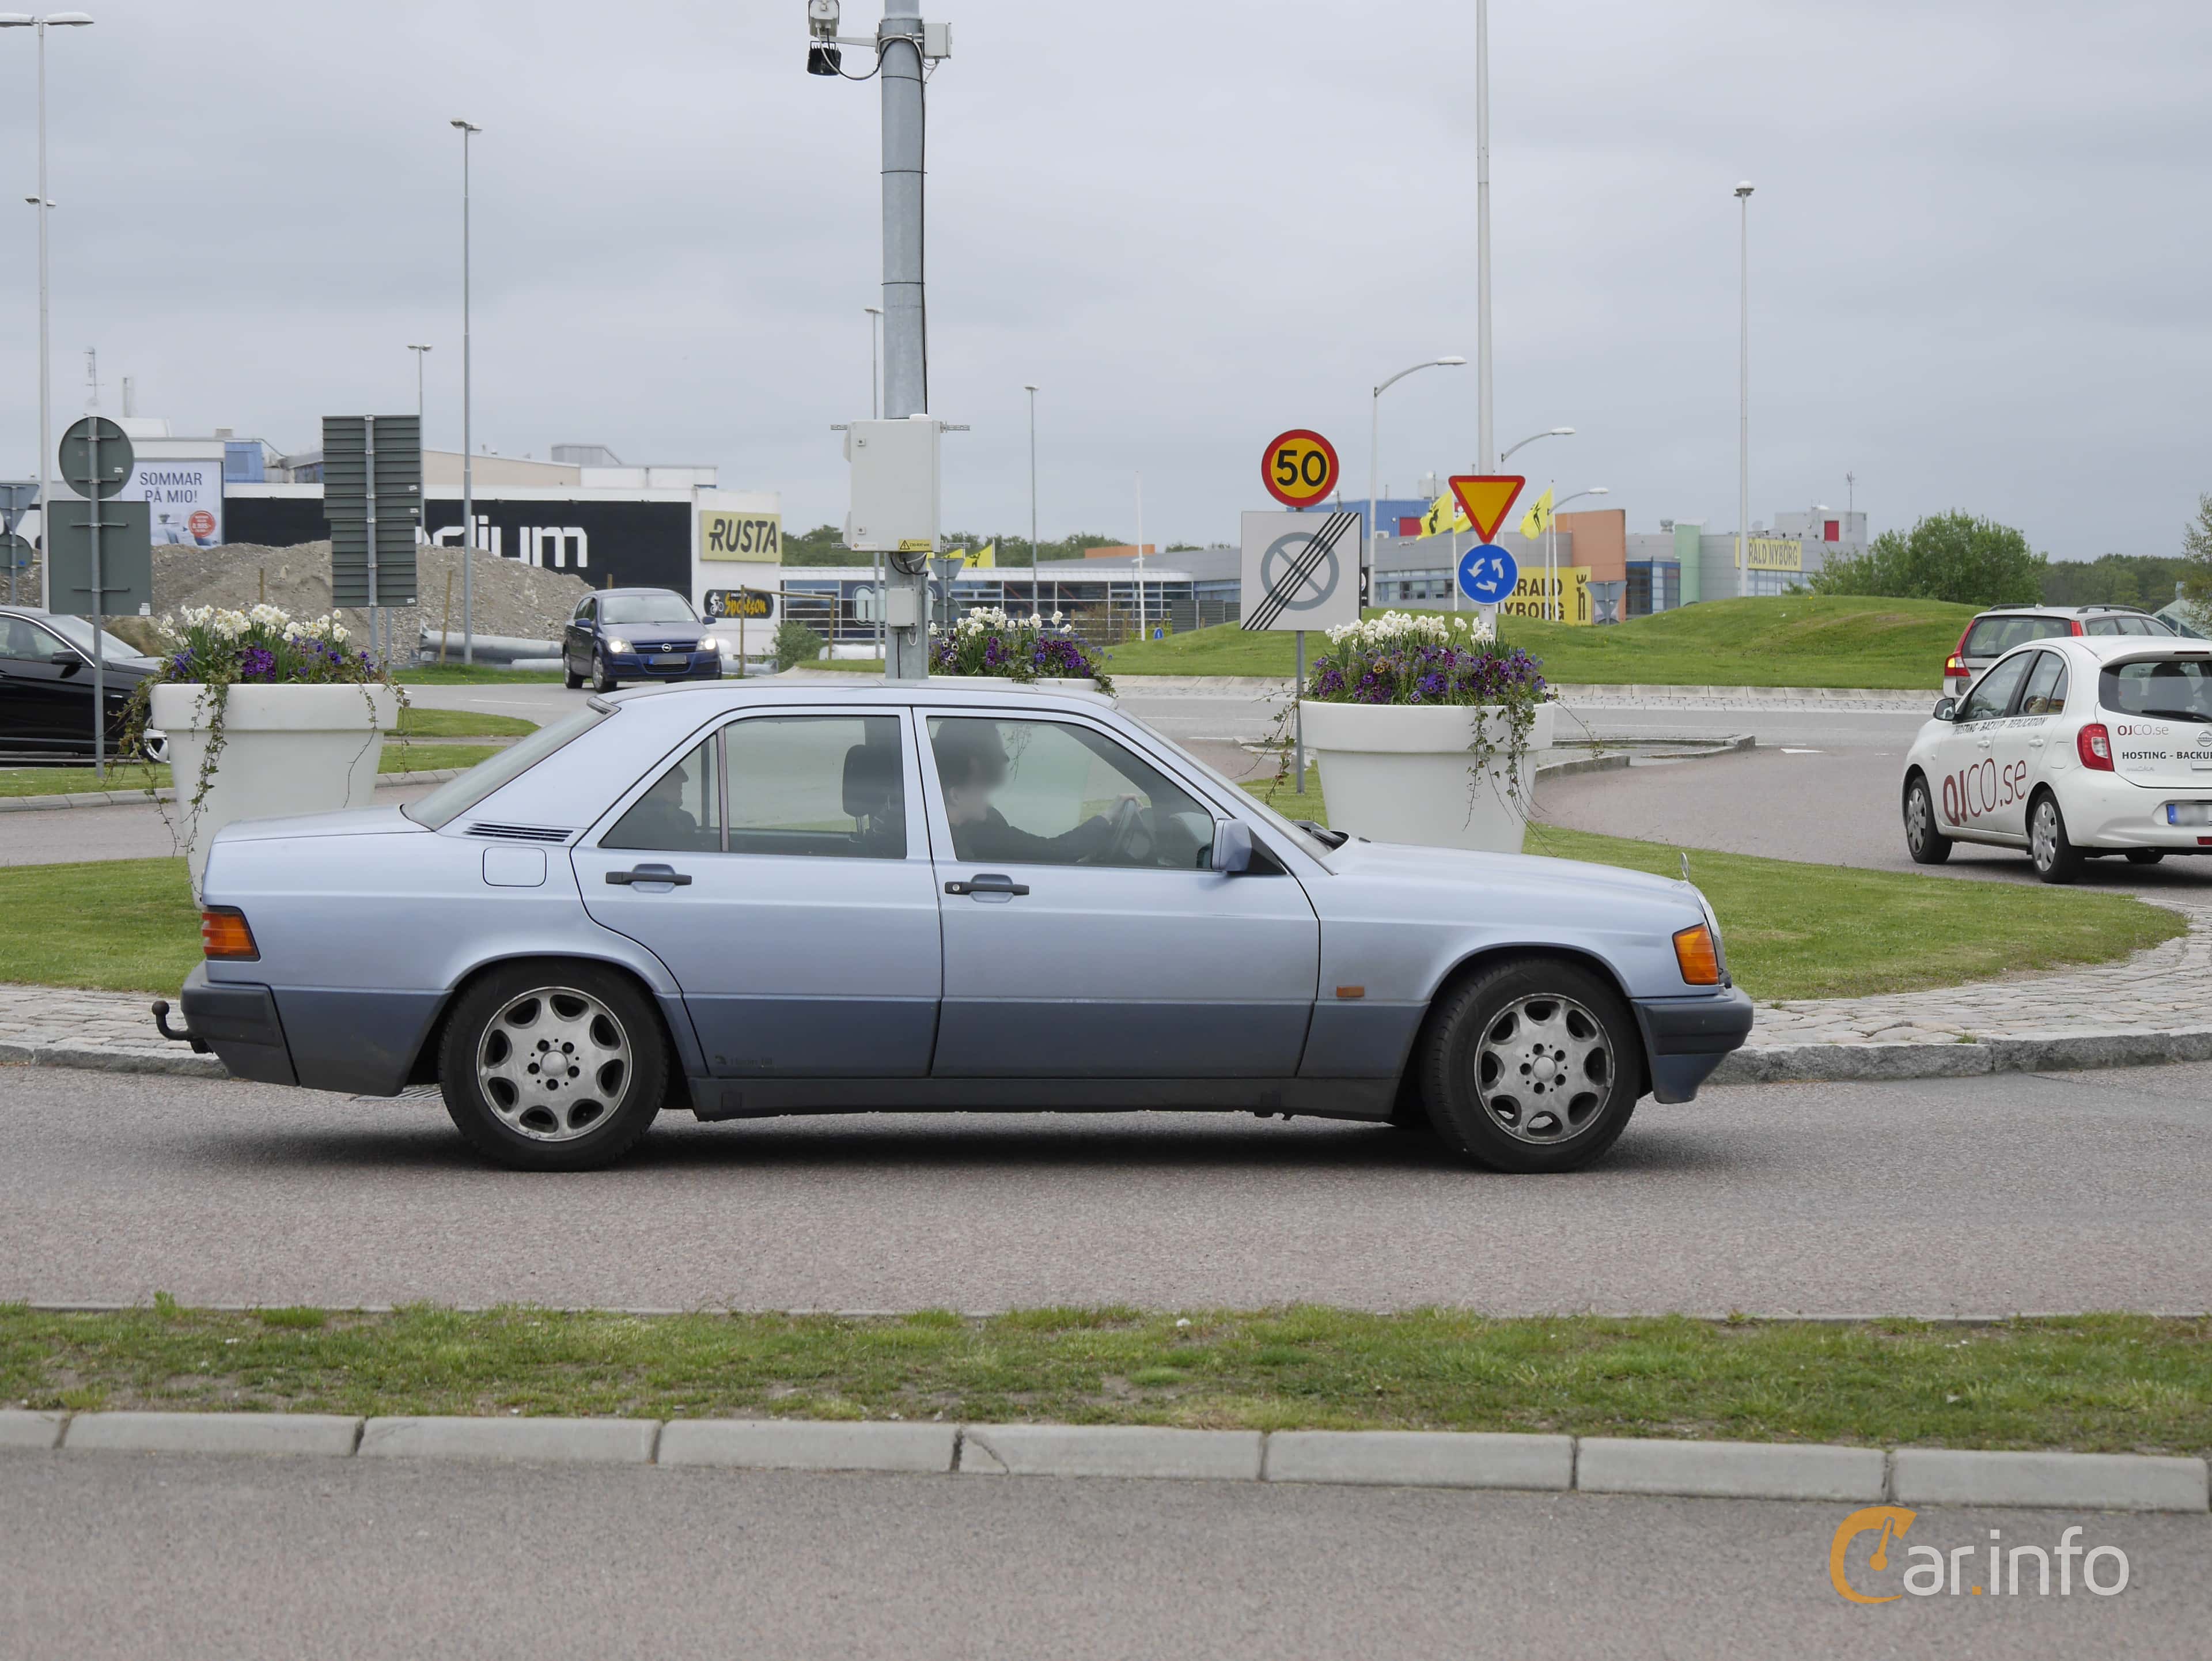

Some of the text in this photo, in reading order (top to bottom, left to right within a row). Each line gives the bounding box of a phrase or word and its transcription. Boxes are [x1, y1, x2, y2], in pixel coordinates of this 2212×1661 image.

[139, 472, 202, 485] SOMMAR
[1277, 450, 1327, 486] 50
[145, 487, 197, 502] PÅ MIO!
[415, 515, 588, 567] dium
[709, 519, 777, 553] RUSTA
[1738, 542, 1797, 566] RALD NYBORG
[1511, 578, 1563, 596] RALD
[724, 592, 766, 616] Spotson
[1498, 602, 1564, 620] YBORG
[2118, 724, 2169, 736] OJCO.se
